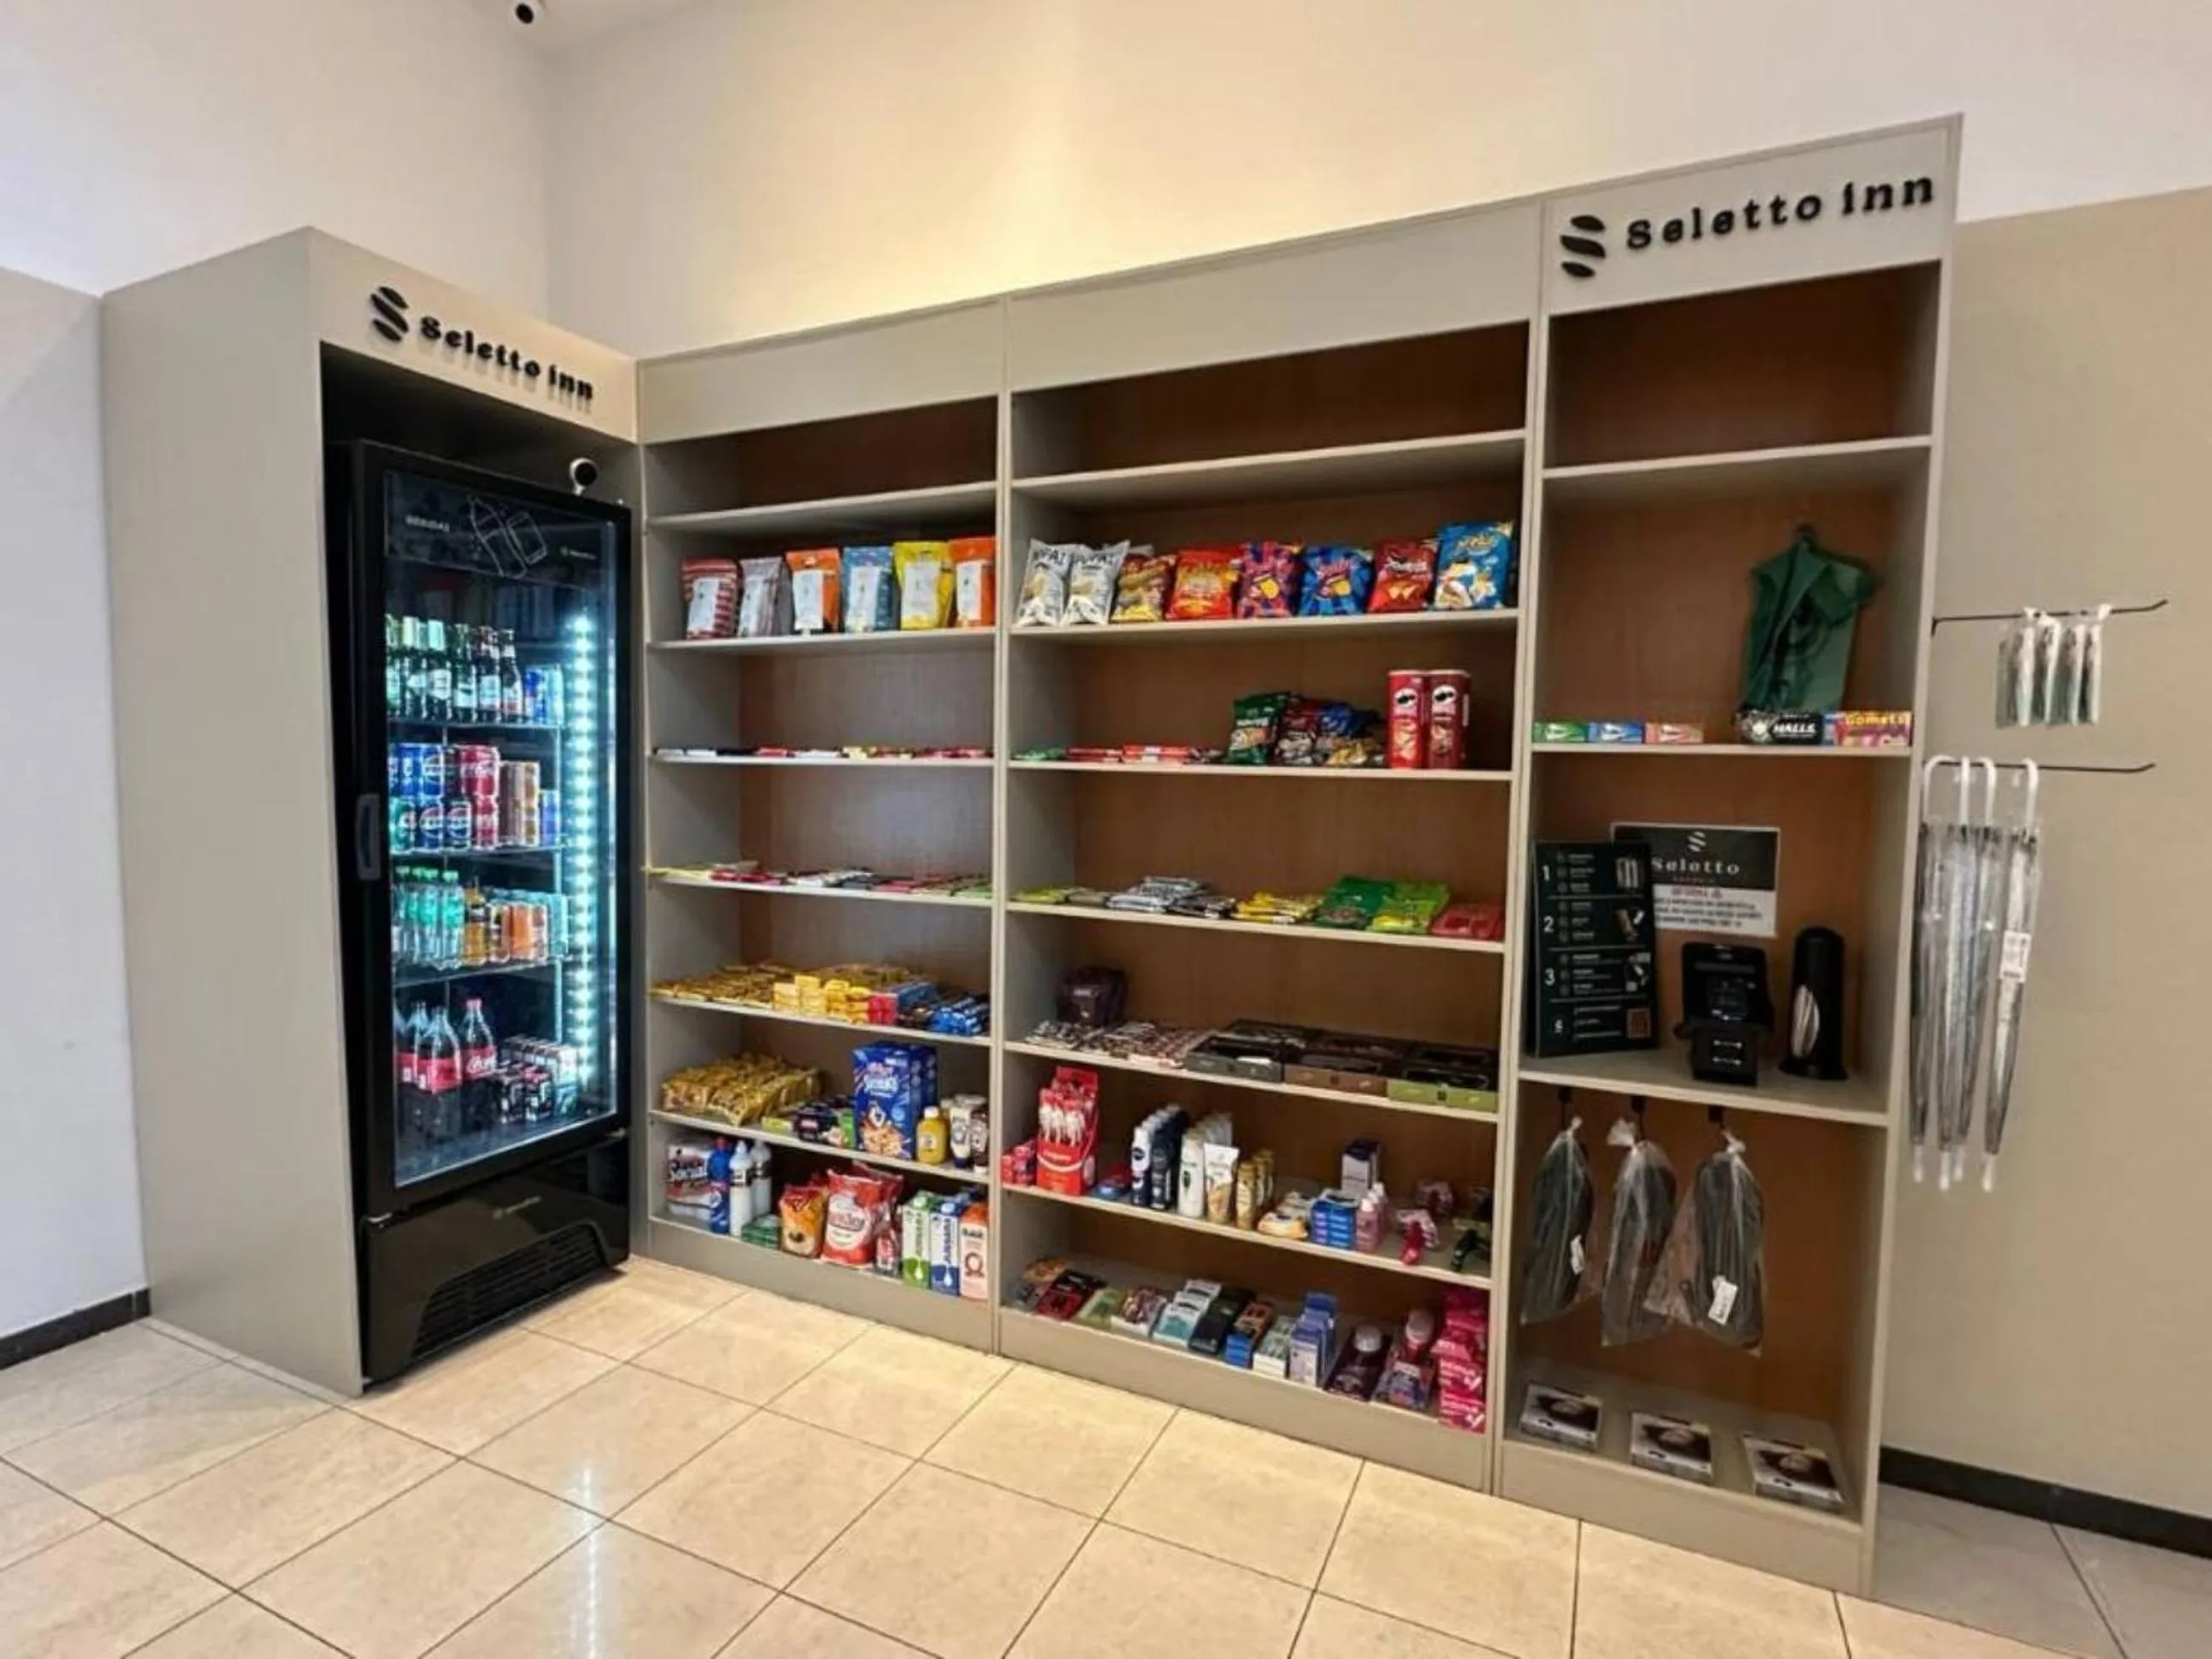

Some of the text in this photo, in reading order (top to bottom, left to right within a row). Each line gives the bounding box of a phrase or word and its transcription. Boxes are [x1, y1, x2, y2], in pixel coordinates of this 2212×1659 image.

[1626, 176, 1934, 251] Seletto inn
[419, 316, 594, 400] Seletto inn
[1542, 864, 1551, 881] 1
[1650, 857, 1741, 875] Seletto
[1542, 915, 1554, 932] 2
[1544, 968, 1555, 986] 3
